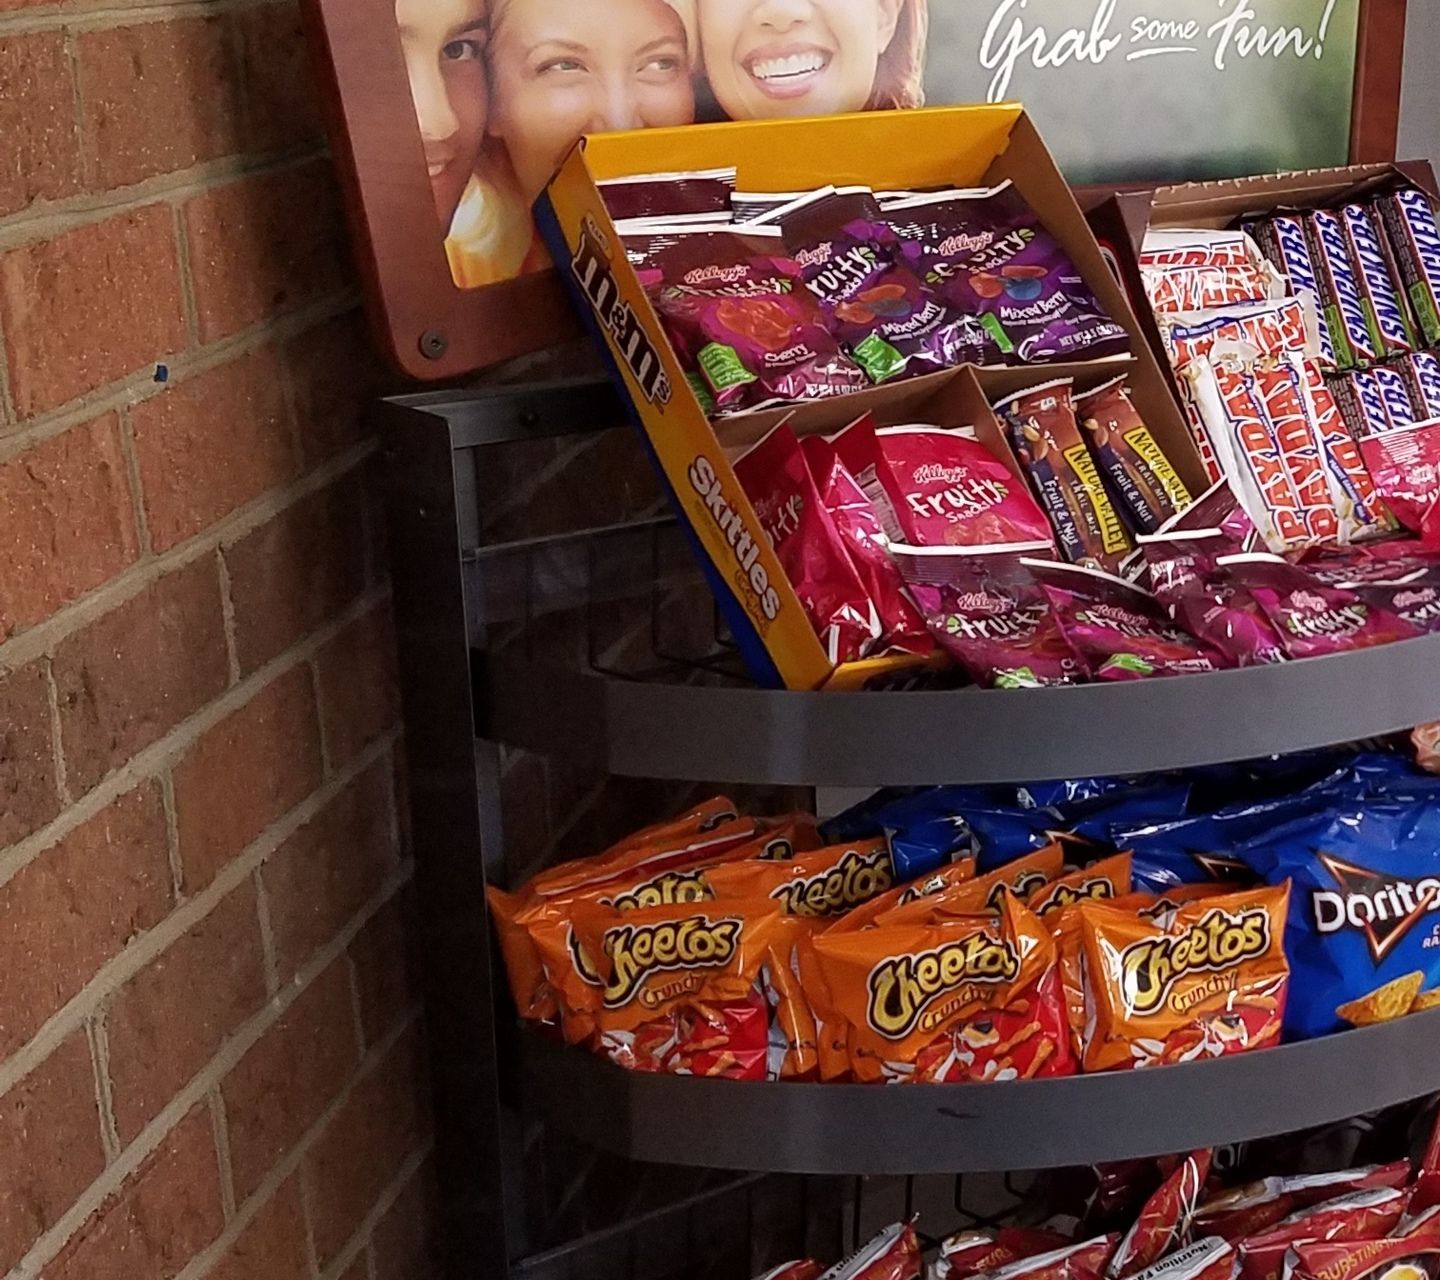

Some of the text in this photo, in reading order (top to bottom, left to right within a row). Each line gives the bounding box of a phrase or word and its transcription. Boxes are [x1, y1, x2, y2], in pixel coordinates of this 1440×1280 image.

[1130, 17, 1200, 43] some
[938, 231, 995, 256] Kellogg's
[683, 265, 750, 284] Kellogg's
[805, 246, 876, 298] ruity
[1315, 211, 1375, 360] SNICKERS
[1345, 205, 1410, 348] SNICKERS
[880, 300, 942, 336] Mixed Berry
[1000, 290, 1068, 321] Mixed Berry
[764, 342, 811, 363] Cherry
[912, 463, 968, 483] Kellogg's
[1213, 366, 1312, 543] PAYDAY
[1253, 368, 1340, 542] PAYDAY
[1110, 463, 1130, 494] Fruit
[1135, 500, 1153, 523] Nut
[1134, 460, 1169, 507] TRAIL MIX
[688, 454, 782, 621] Skittles
[1044, 479, 1062, 512] Fruit
[1062, 521, 1079, 546] Nut
[1097, 499, 1128, 552] VALLEY
[1120, 907, 1271, 1016] Cheetos
[1168, 967, 1239, 1015] Crunchy
